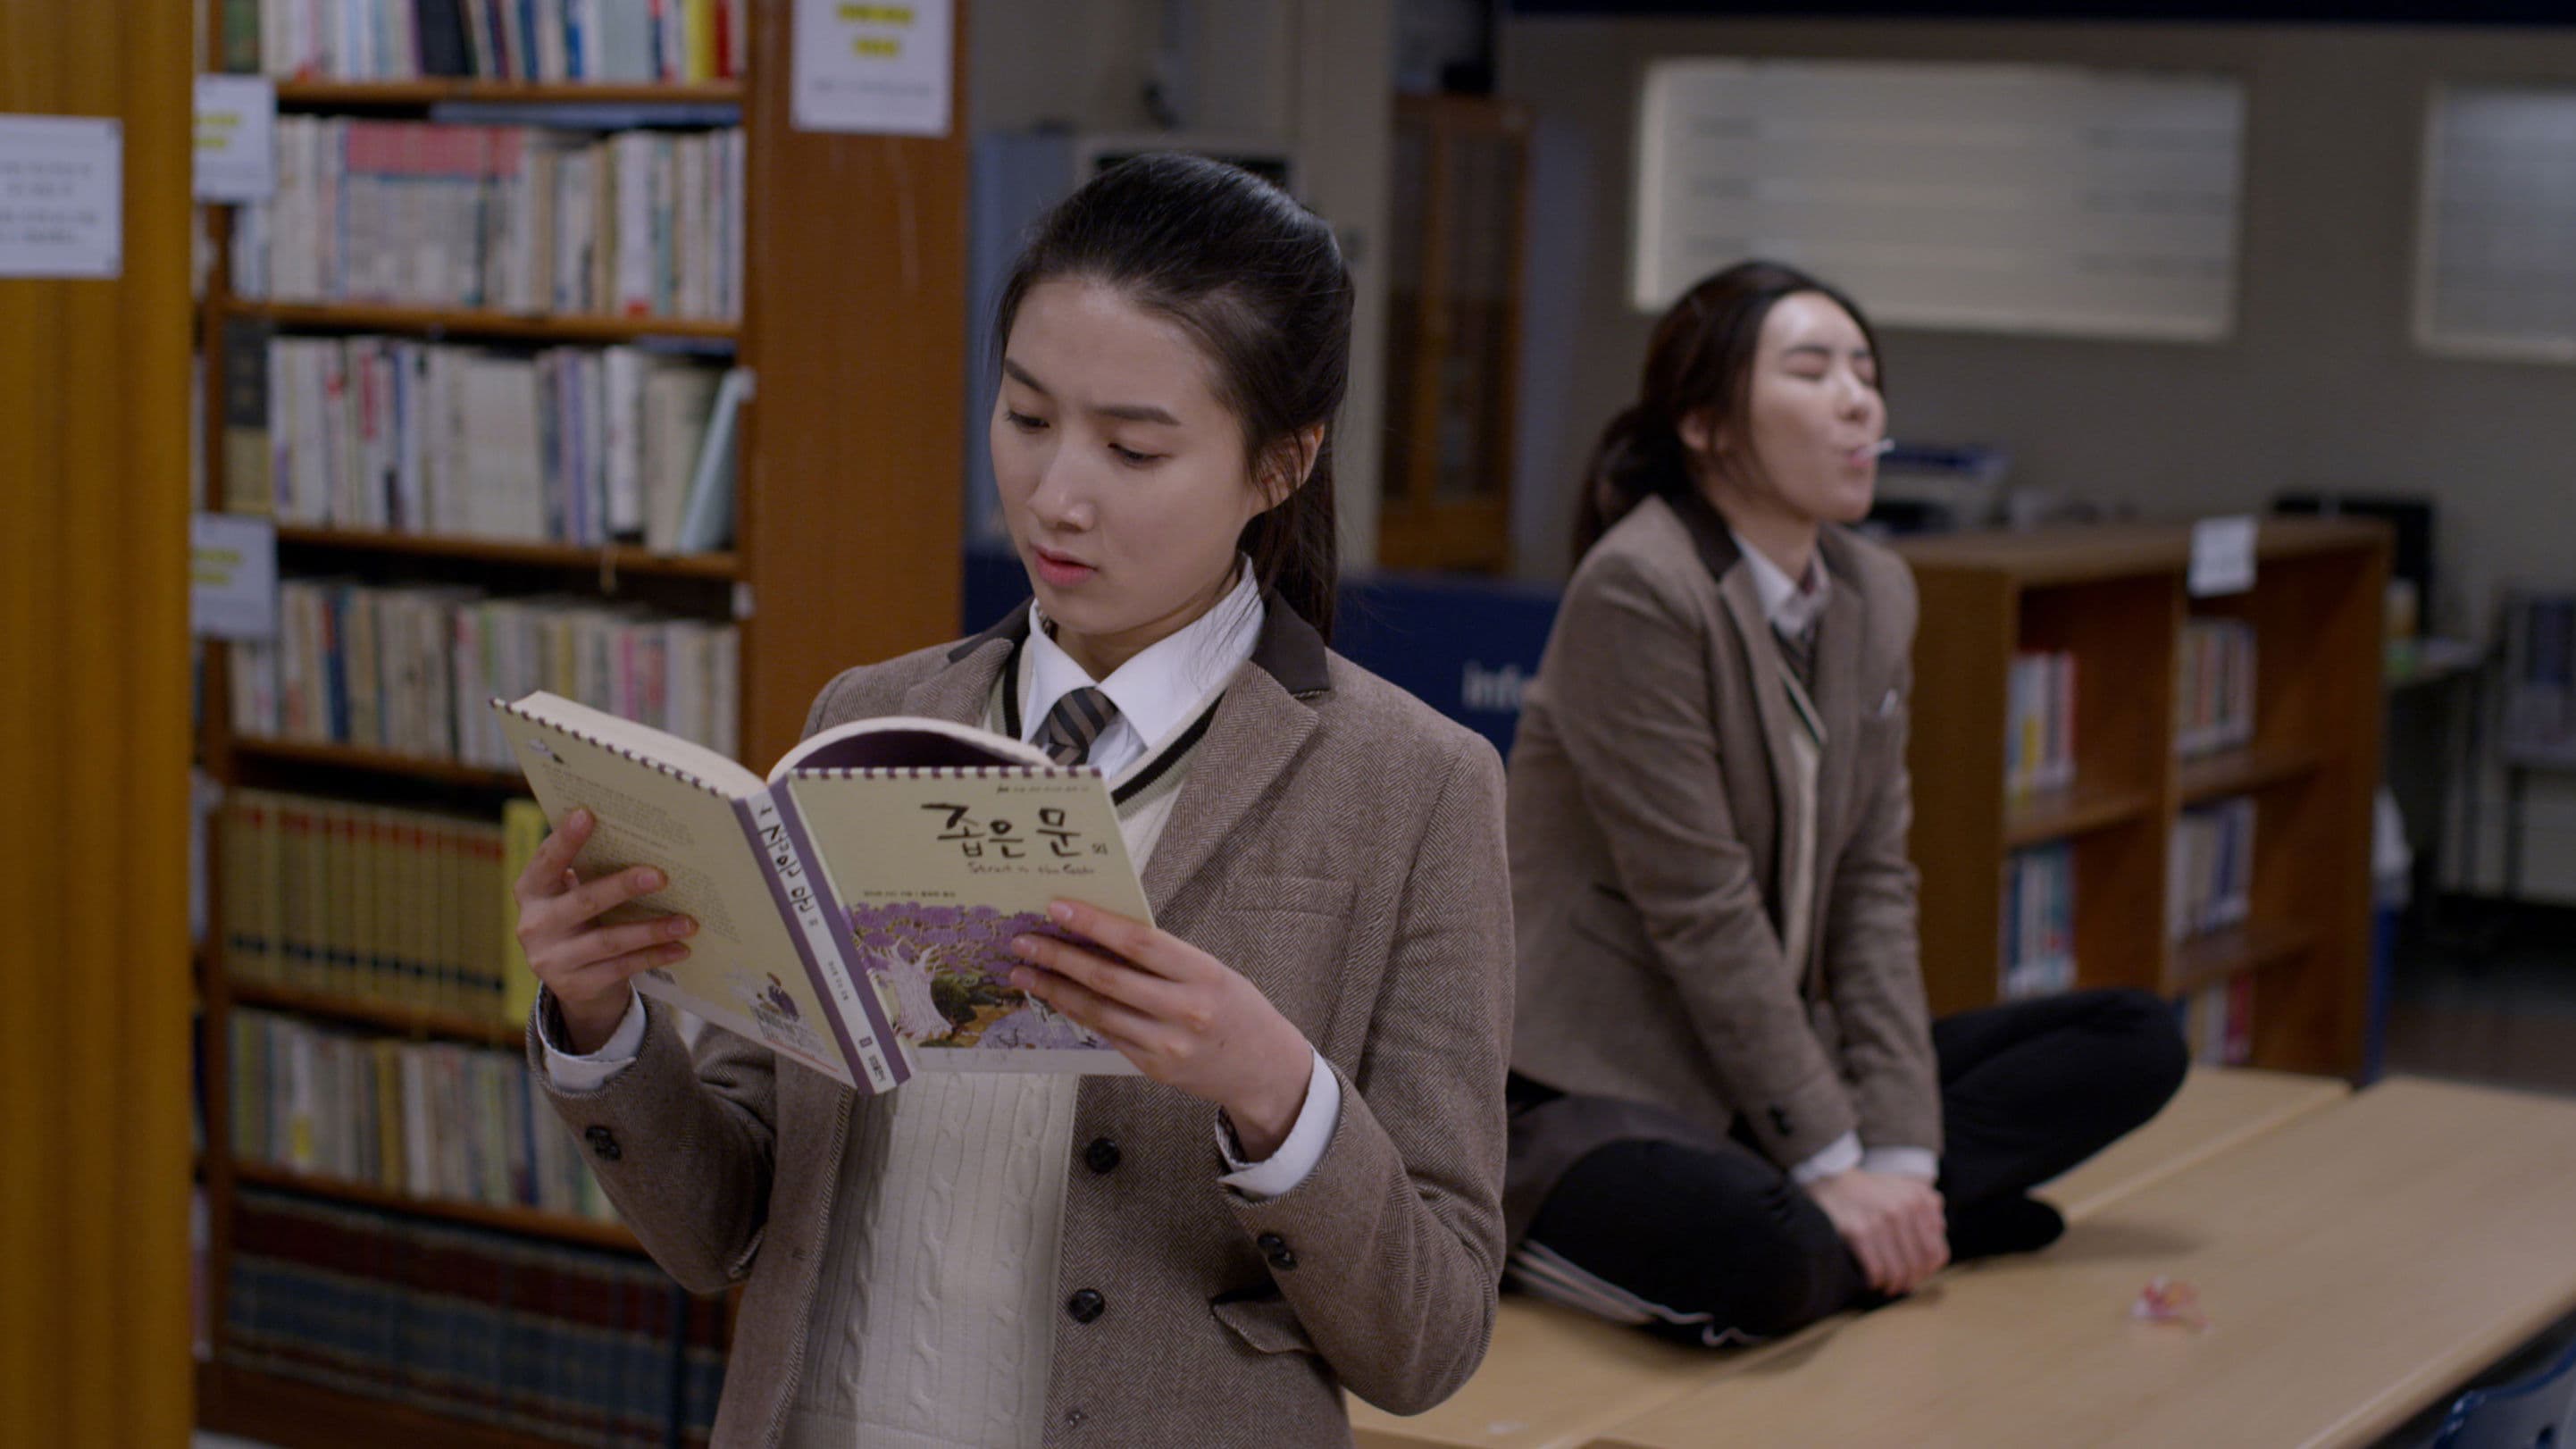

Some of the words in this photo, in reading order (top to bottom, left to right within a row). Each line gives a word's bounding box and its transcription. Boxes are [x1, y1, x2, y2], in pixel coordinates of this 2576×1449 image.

[921, 802, 1025, 859] 좁은
[1036, 807, 1082, 857] 문
[757, 823, 802, 878] 좁은
[789, 885, 817, 913] 문
